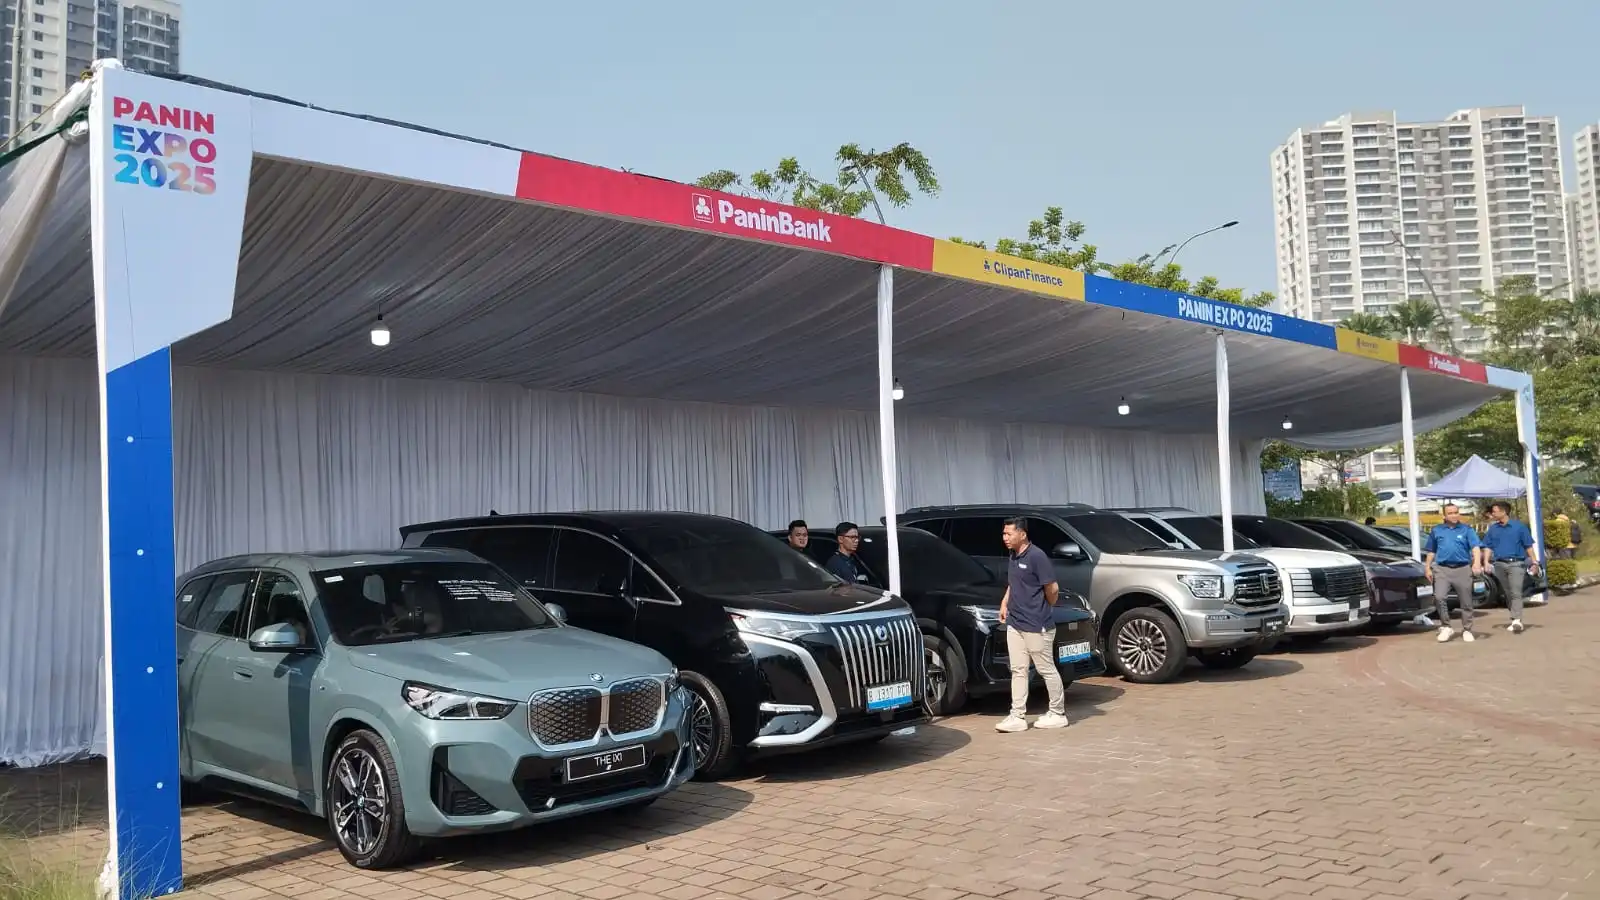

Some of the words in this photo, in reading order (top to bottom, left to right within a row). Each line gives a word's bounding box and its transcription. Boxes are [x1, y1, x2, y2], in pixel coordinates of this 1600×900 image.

[113, 96, 215, 135] PANIN
[113, 123, 217, 164] EXPO
[113, 152, 217, 196] 2025
[717, 199, 832, 243] PaninBank
[993, 261, 1063, 287] ClipanFinance
[1178, 297, 1213, 322] PANIN
[1214, 305, 1245, 328] EXPO
[1246, 311, 1273, 333] 2025
[594, 754, 612, 767] THE
